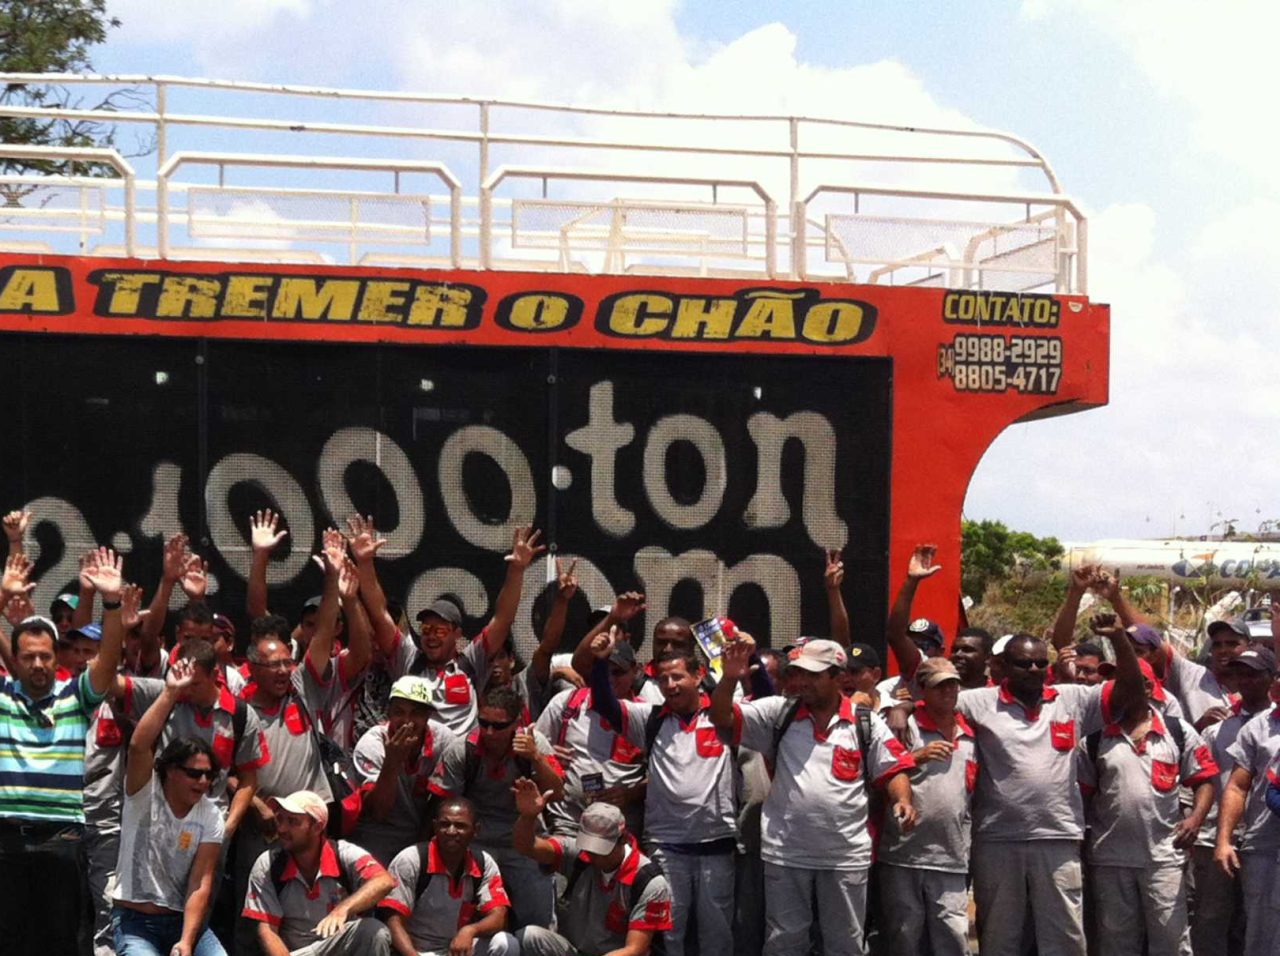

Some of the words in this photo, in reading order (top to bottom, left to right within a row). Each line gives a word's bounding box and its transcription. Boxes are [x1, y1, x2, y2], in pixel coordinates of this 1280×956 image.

[101, 271, 473, 327] TREMER
[508, 293, 569, 330] O
[608, 290, 863, 342] CHÃO
[944, 294, 1059, 324] CONTATO:
[954, 336, 1062, 364] 9988-2929
[954, 364, 1062, 392] 8805-4717
